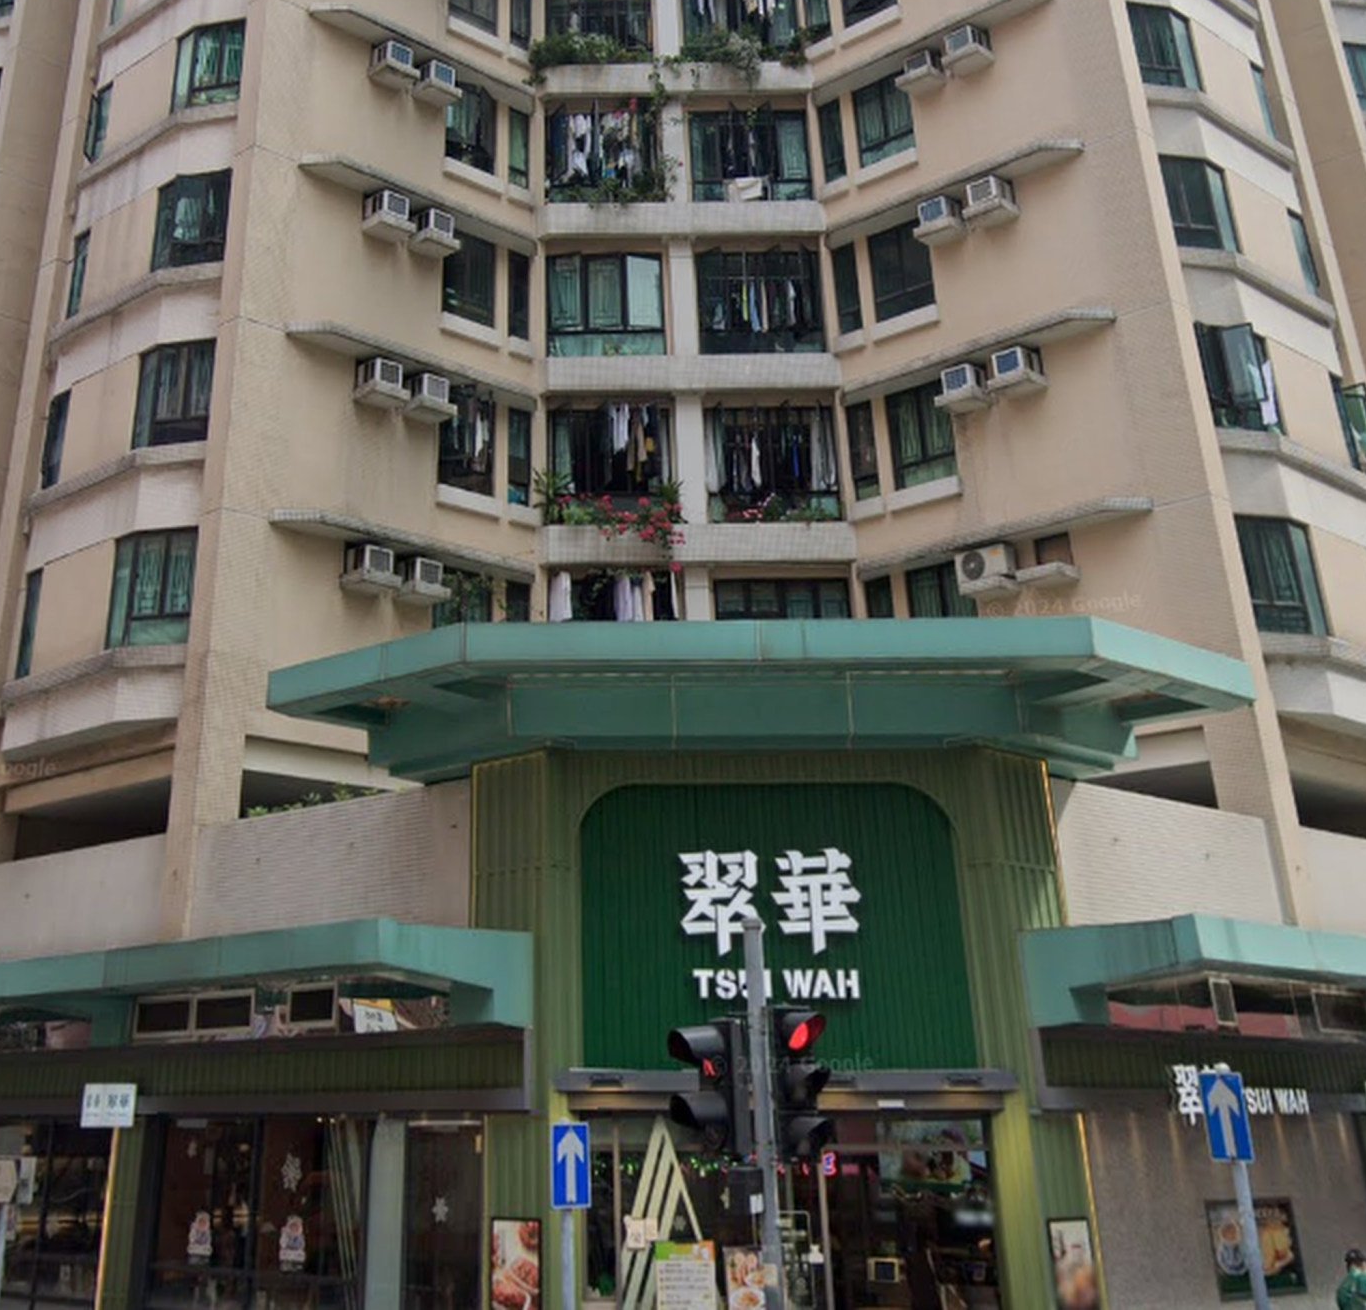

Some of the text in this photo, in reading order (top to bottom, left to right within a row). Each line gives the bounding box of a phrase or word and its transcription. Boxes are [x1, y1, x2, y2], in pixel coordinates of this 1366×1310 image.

[677, 847, 863, 956] 翠華
[782, 968, 861, 1000] WAH
[1272, 1087, 1311, 1116] WAH
